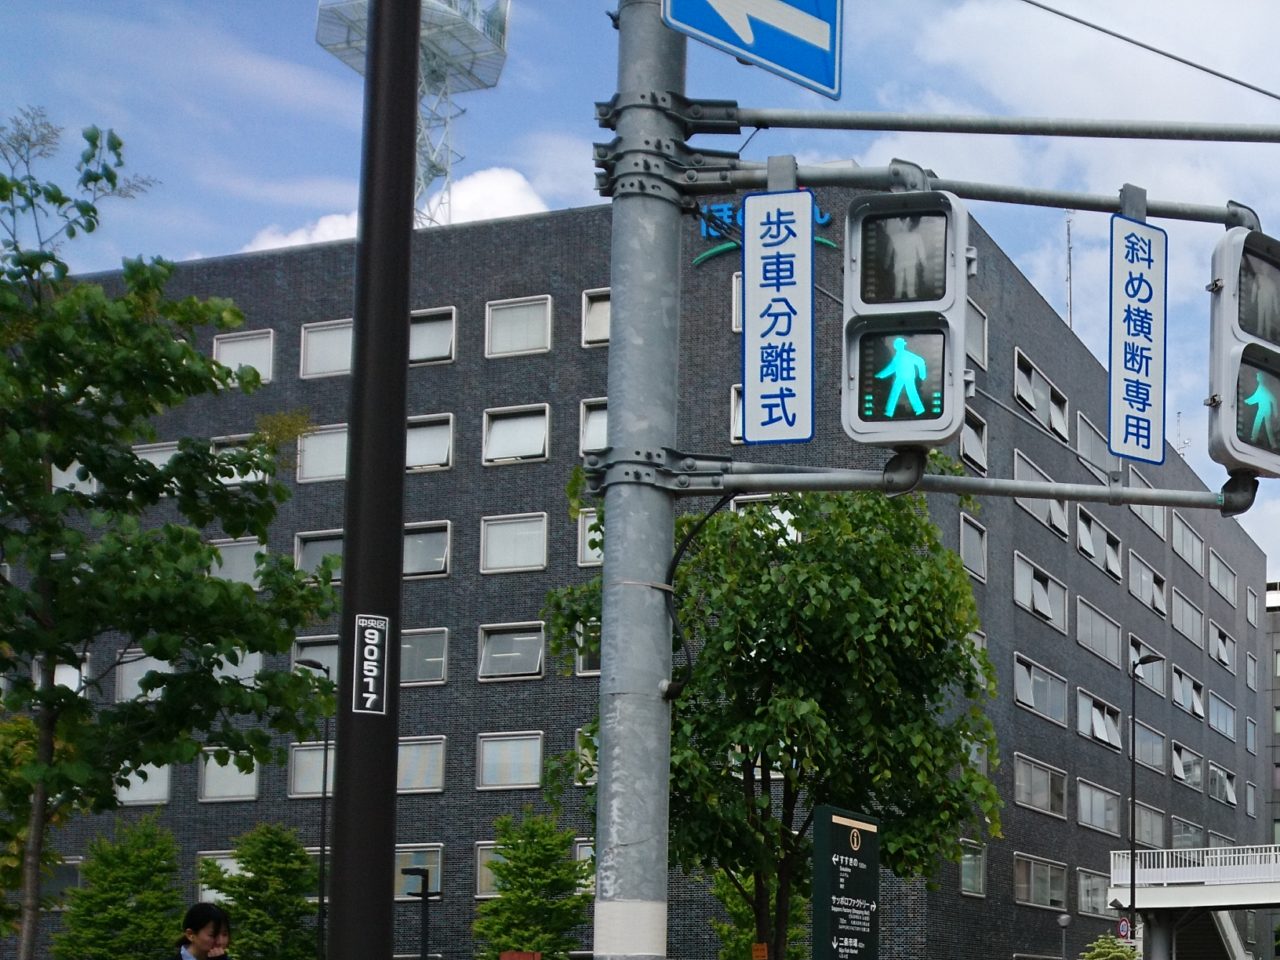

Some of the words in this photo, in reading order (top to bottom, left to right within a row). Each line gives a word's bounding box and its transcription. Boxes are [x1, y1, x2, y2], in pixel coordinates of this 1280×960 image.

[760, 208, 798, 428] 歩車分離式
[1122, 232, 1155, 450] 斜め横断専用
[358, 618, 386, 630] 中央区
[362, 629, 380, 708] 90517
